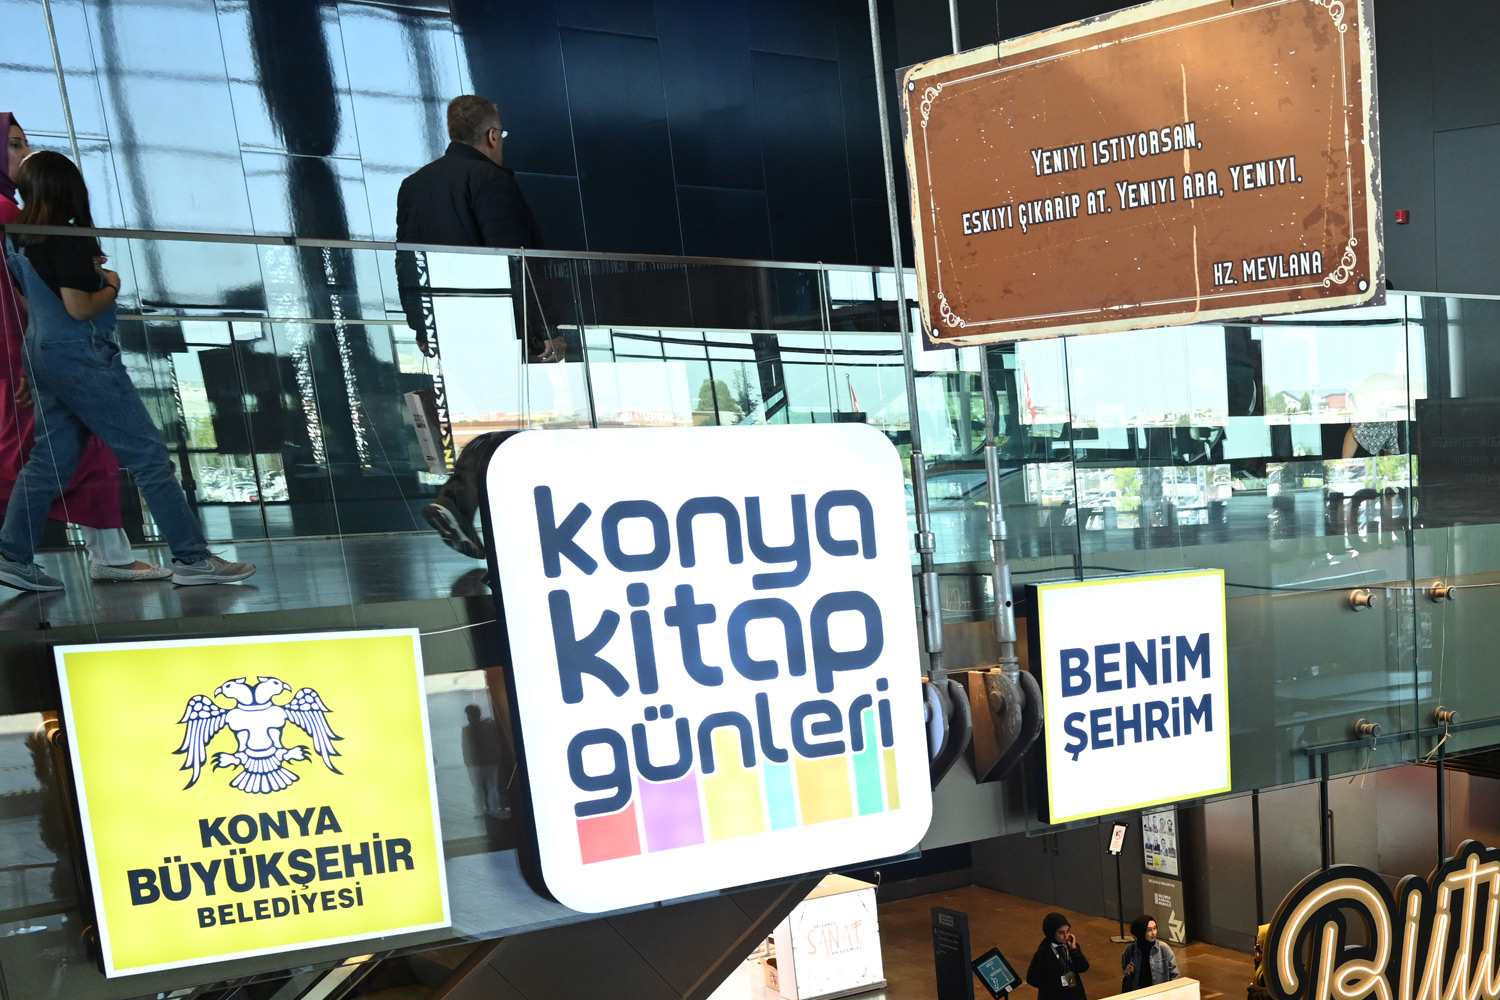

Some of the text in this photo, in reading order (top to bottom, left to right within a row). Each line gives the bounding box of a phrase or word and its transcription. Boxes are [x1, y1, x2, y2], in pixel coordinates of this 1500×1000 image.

[1018, 194, 1081, 233] ÇIKARIP
[1086, 189, 1113, 217] AT.
[1182, 168, 1225, 200] ARA,
[1213, 250, 1323, 287] HZ. MEVLANA
[533, 484, 878, 591] konya
[547, 581, 884, 705] kitap
[1059, 631, 1212, 699] BENİM
[567, 677, 895, 819] günleri
[1063, 692, 1214, 762] ŞEHRİM
[198, 805, 342, 850] KONYA
[127, 833, 415, 908] BÜYÜKŞEHİR
[197, 882, 365, 930] BELEDİYESİ
